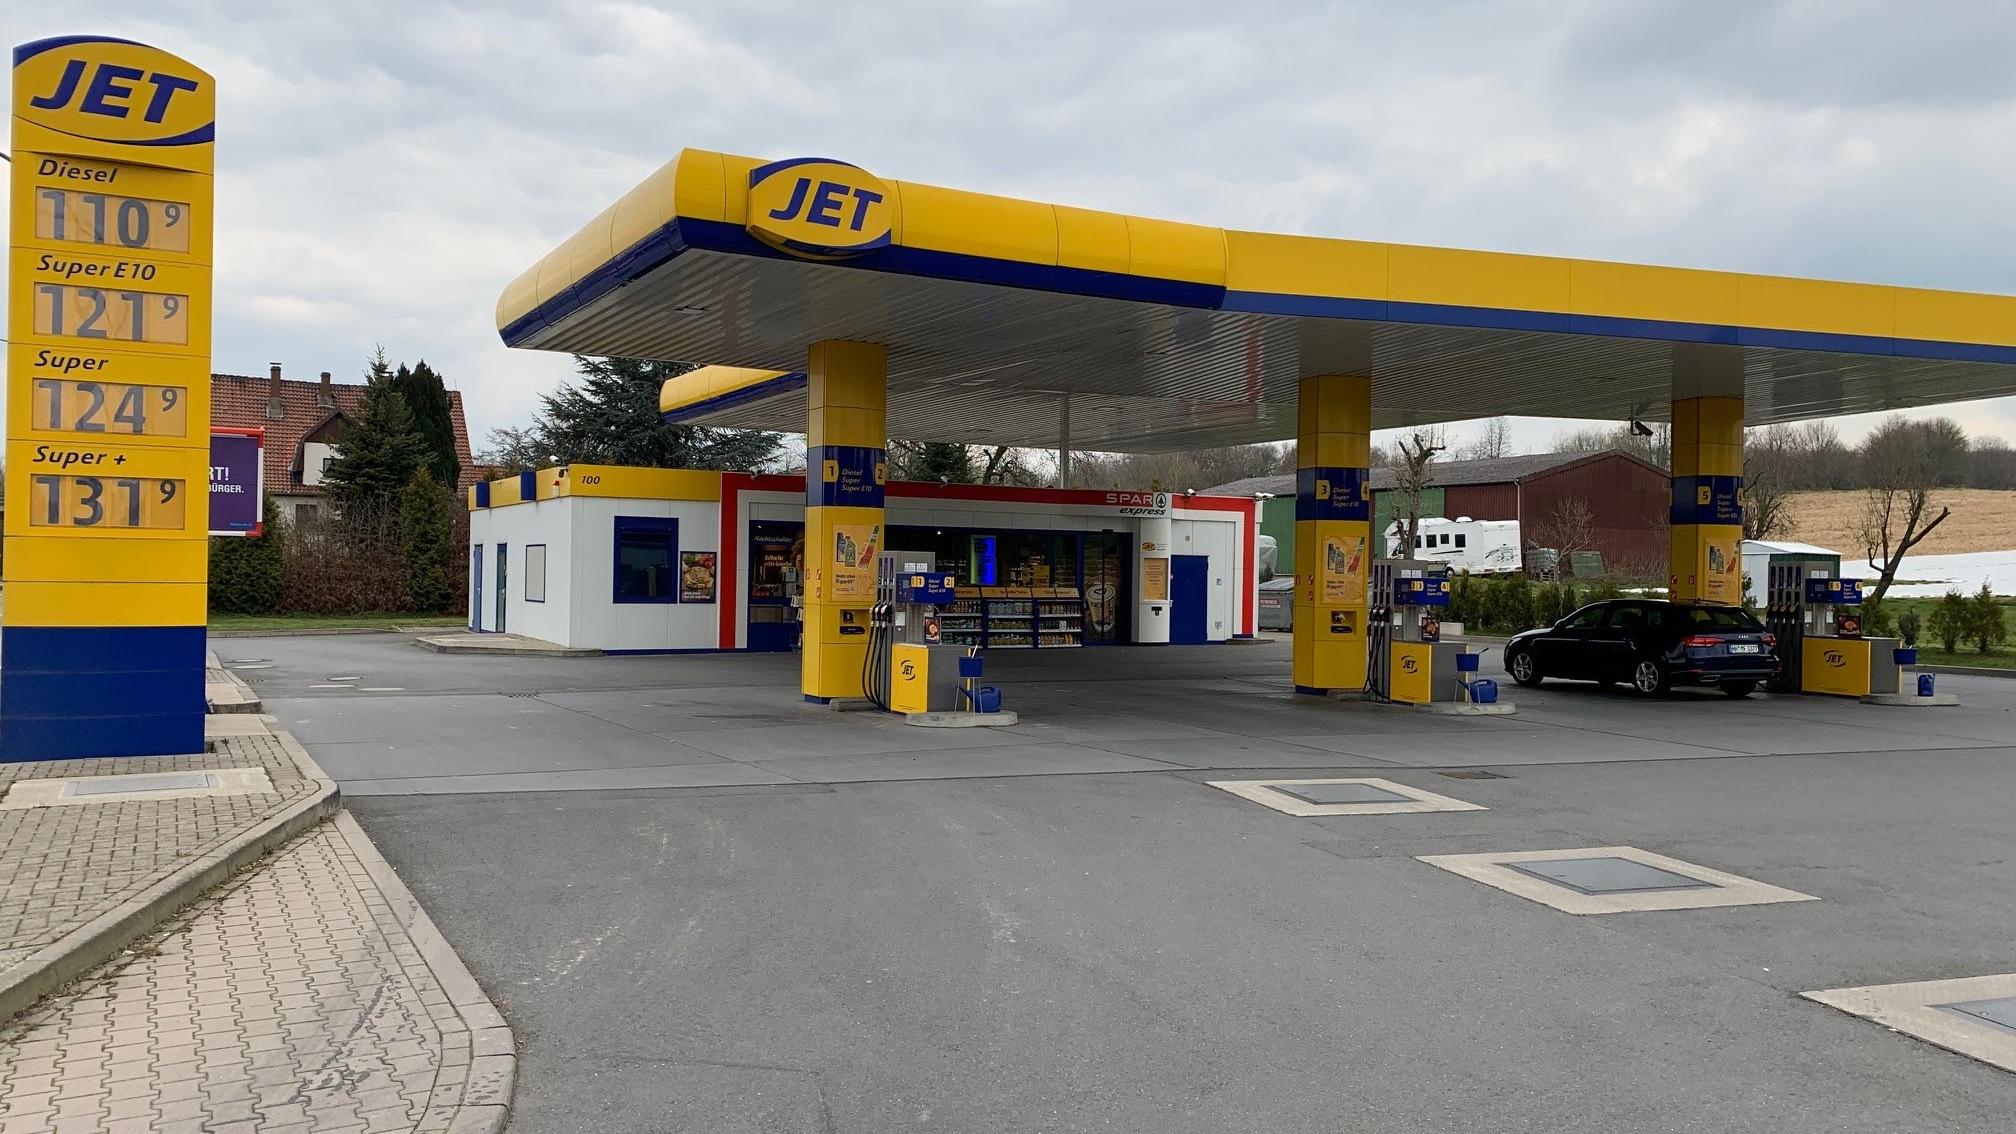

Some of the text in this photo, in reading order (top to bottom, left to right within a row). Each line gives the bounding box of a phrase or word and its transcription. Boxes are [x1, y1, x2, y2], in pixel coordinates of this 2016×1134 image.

[30, 60, 198, 123] JET
[38, 159, 119, 183] Diesel
[768, 177, 883, 232] JET
[36, 254, 156, 281] Super E10
[34, 350, 109, 374] Super
[32, 446, 107, 469] Super
[828, 465, 835, 477] 1
[842, 468, 863, 476] Diesel
[877, 468, 883, 480] 2
[581, 475, 601, 485] 100
[841, 477, 861, 485] Super
[841, 484, 860, 493] Super
[1320, 484, 1327, 495] 3
[1362, 485, 1368, 496] 4
[1106, 493, 1153, 505] SPAR
[1702, 490, 1708, 500] 5
[1119, 507, 1166, 516] express
[1403, 659, 1417, 669] JET
[1826, 654, 1843, 664] JET
[902, 665, 915, 675] JET
